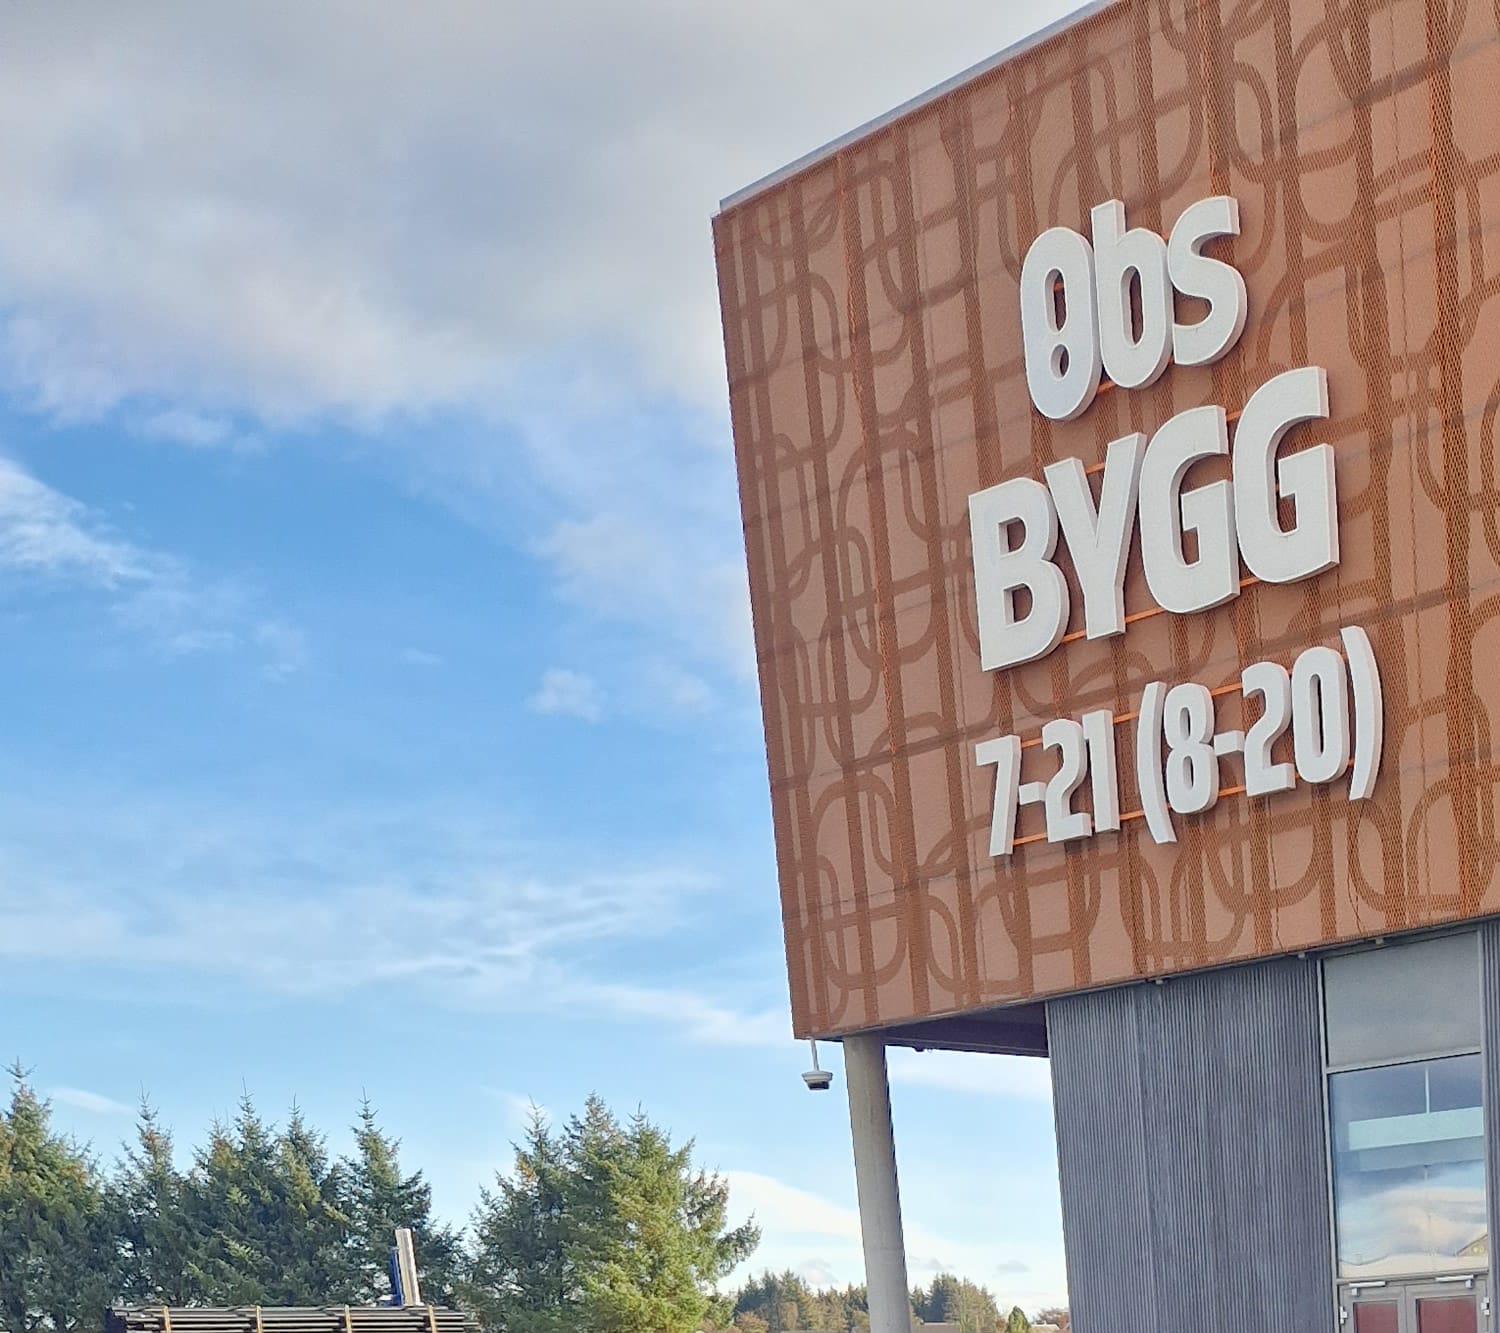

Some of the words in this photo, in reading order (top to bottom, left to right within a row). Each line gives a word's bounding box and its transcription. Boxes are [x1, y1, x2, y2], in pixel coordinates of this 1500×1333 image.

[1020, 196, 1247, 421] Obs
[968, 367, 1340, 672] BYGG
[975, 709, 1120, 857] 7-21
[1137, 626, 1382, 844] (8-20)
